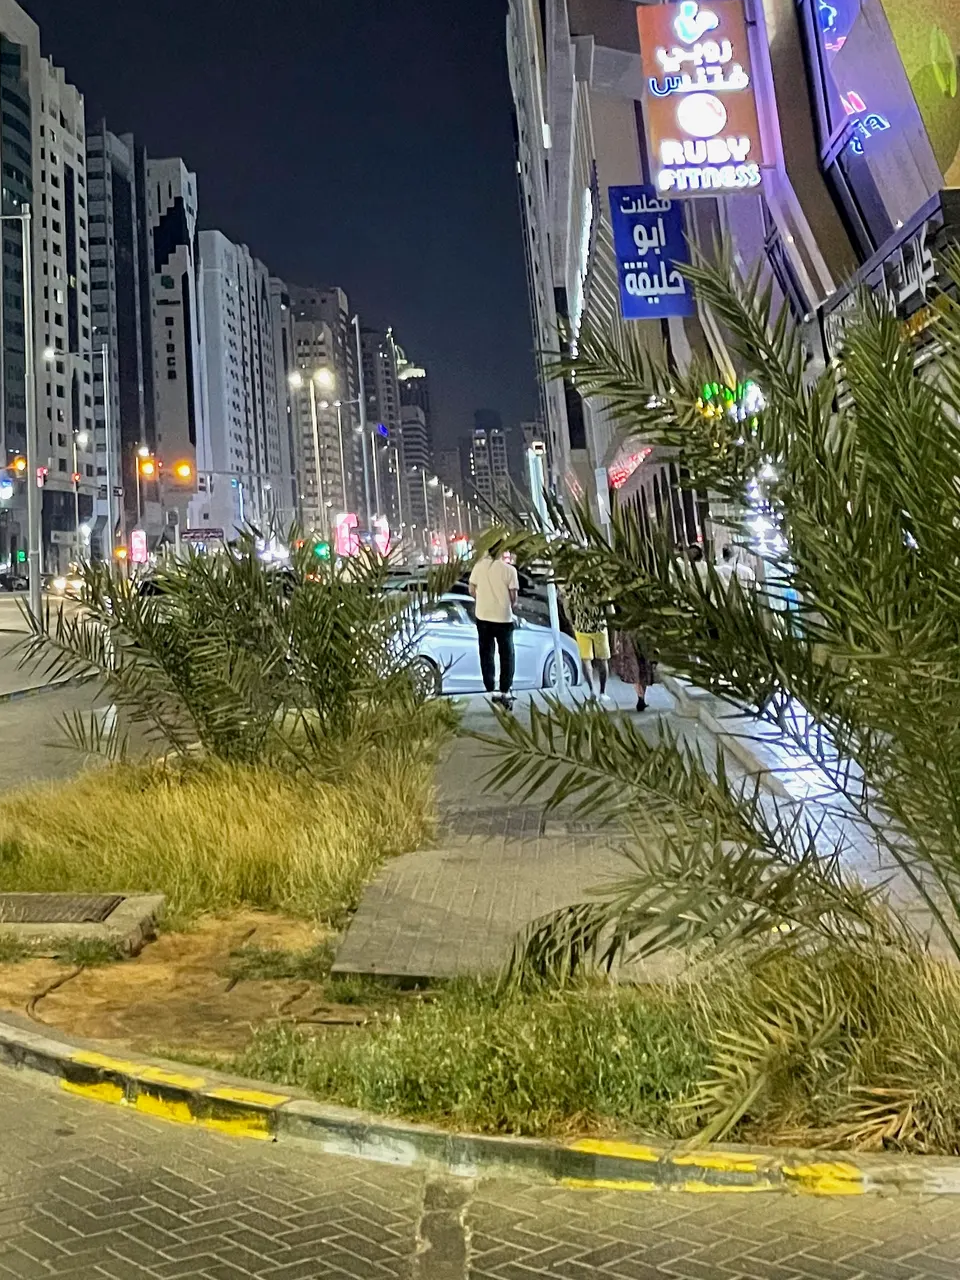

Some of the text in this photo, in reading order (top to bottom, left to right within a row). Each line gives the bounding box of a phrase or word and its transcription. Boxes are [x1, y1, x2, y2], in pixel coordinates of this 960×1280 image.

[656, 40, 733, 73] روبي
[661, 138, 751, 165] RUBY
[658, 163, 761, 190] FITNESS
[620, 194, 672, 214] محلات
